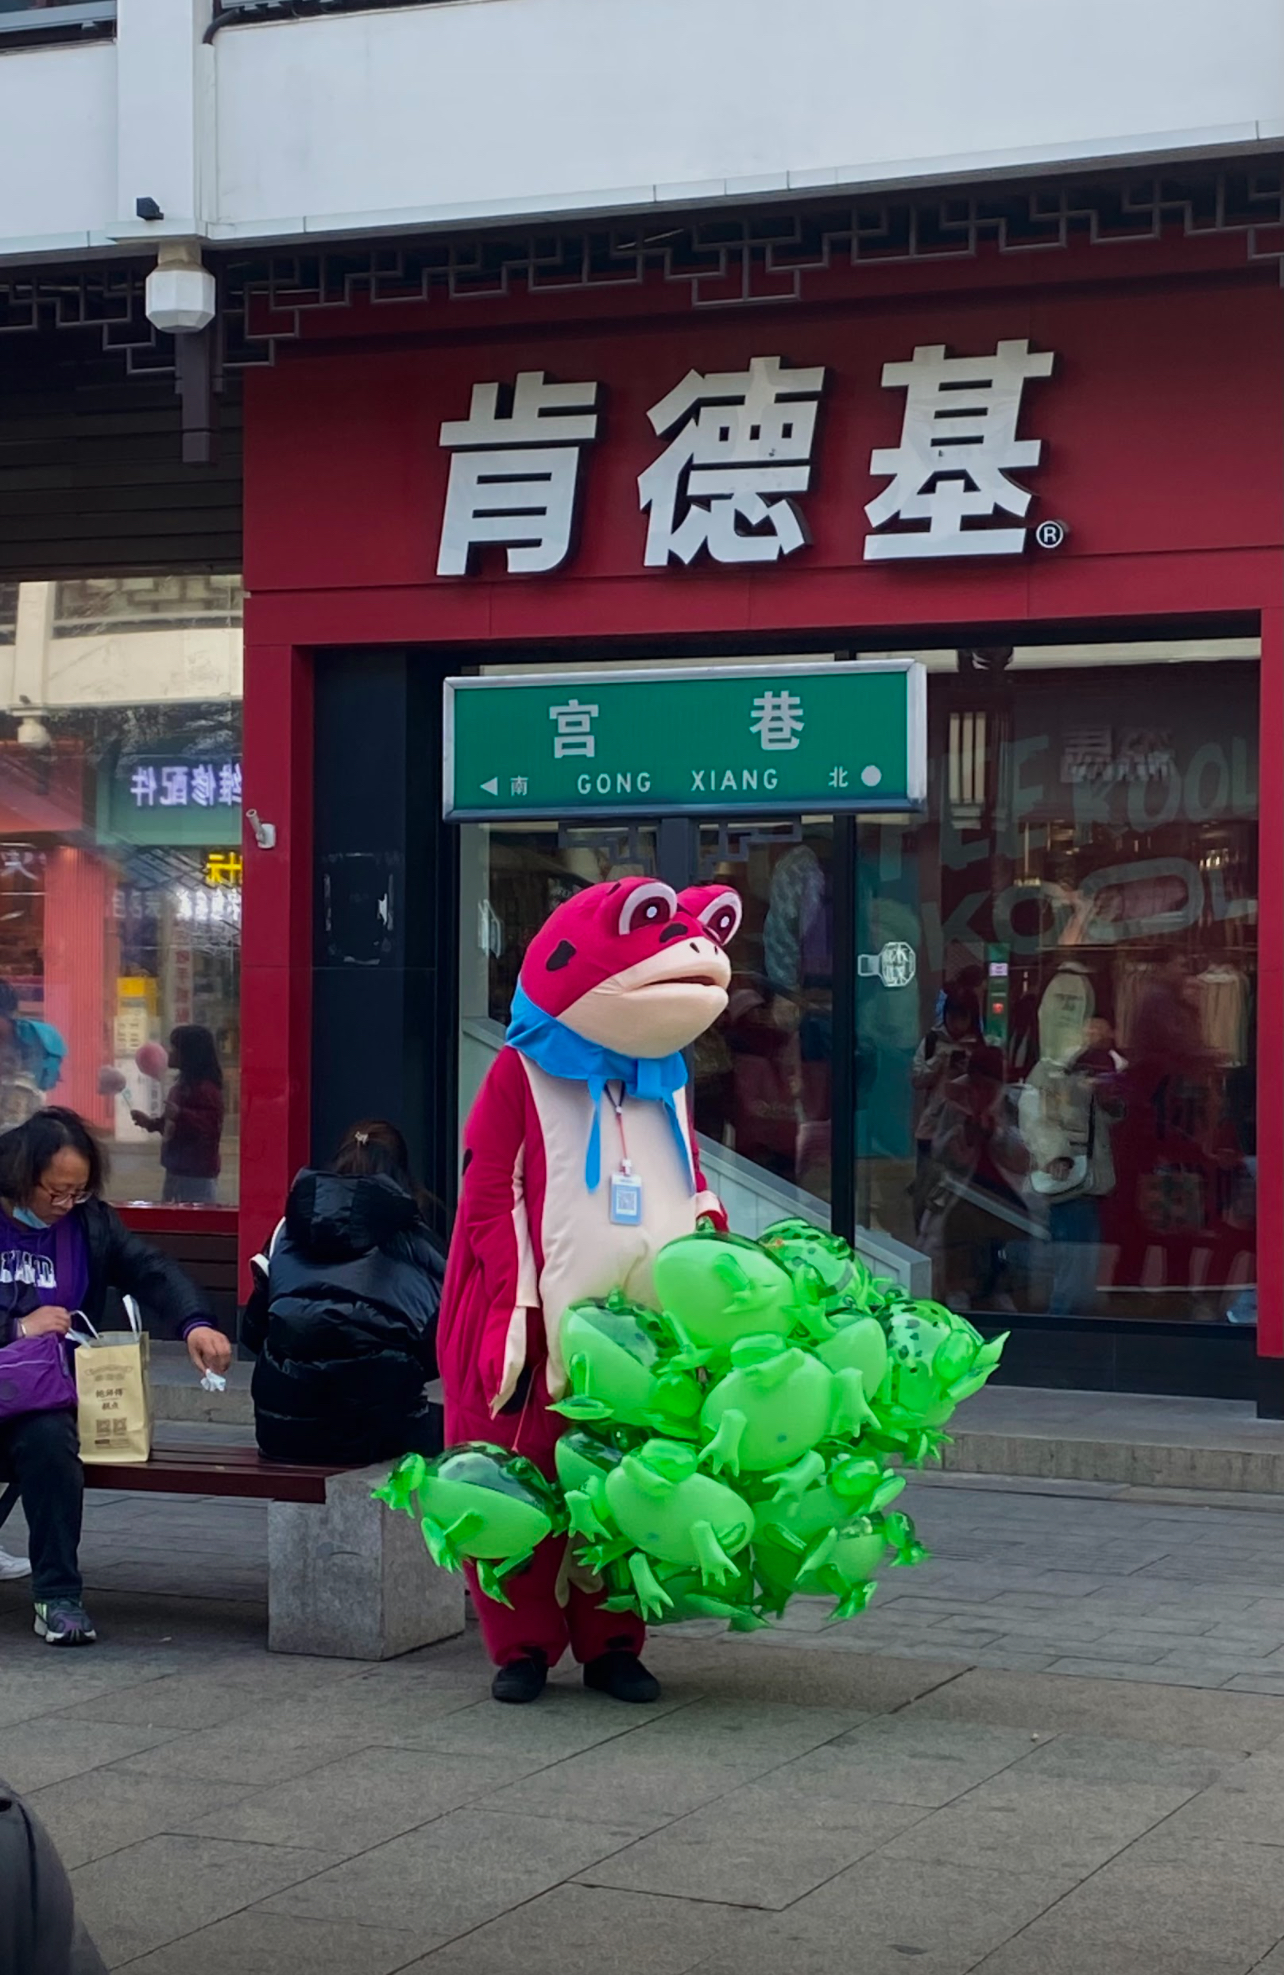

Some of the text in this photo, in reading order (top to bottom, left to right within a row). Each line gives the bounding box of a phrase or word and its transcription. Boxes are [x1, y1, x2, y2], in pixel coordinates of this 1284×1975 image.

[436, 338, 1055, 577] 肯德基
[510, 766, 849, 797] 南 GONG XIANG 北
